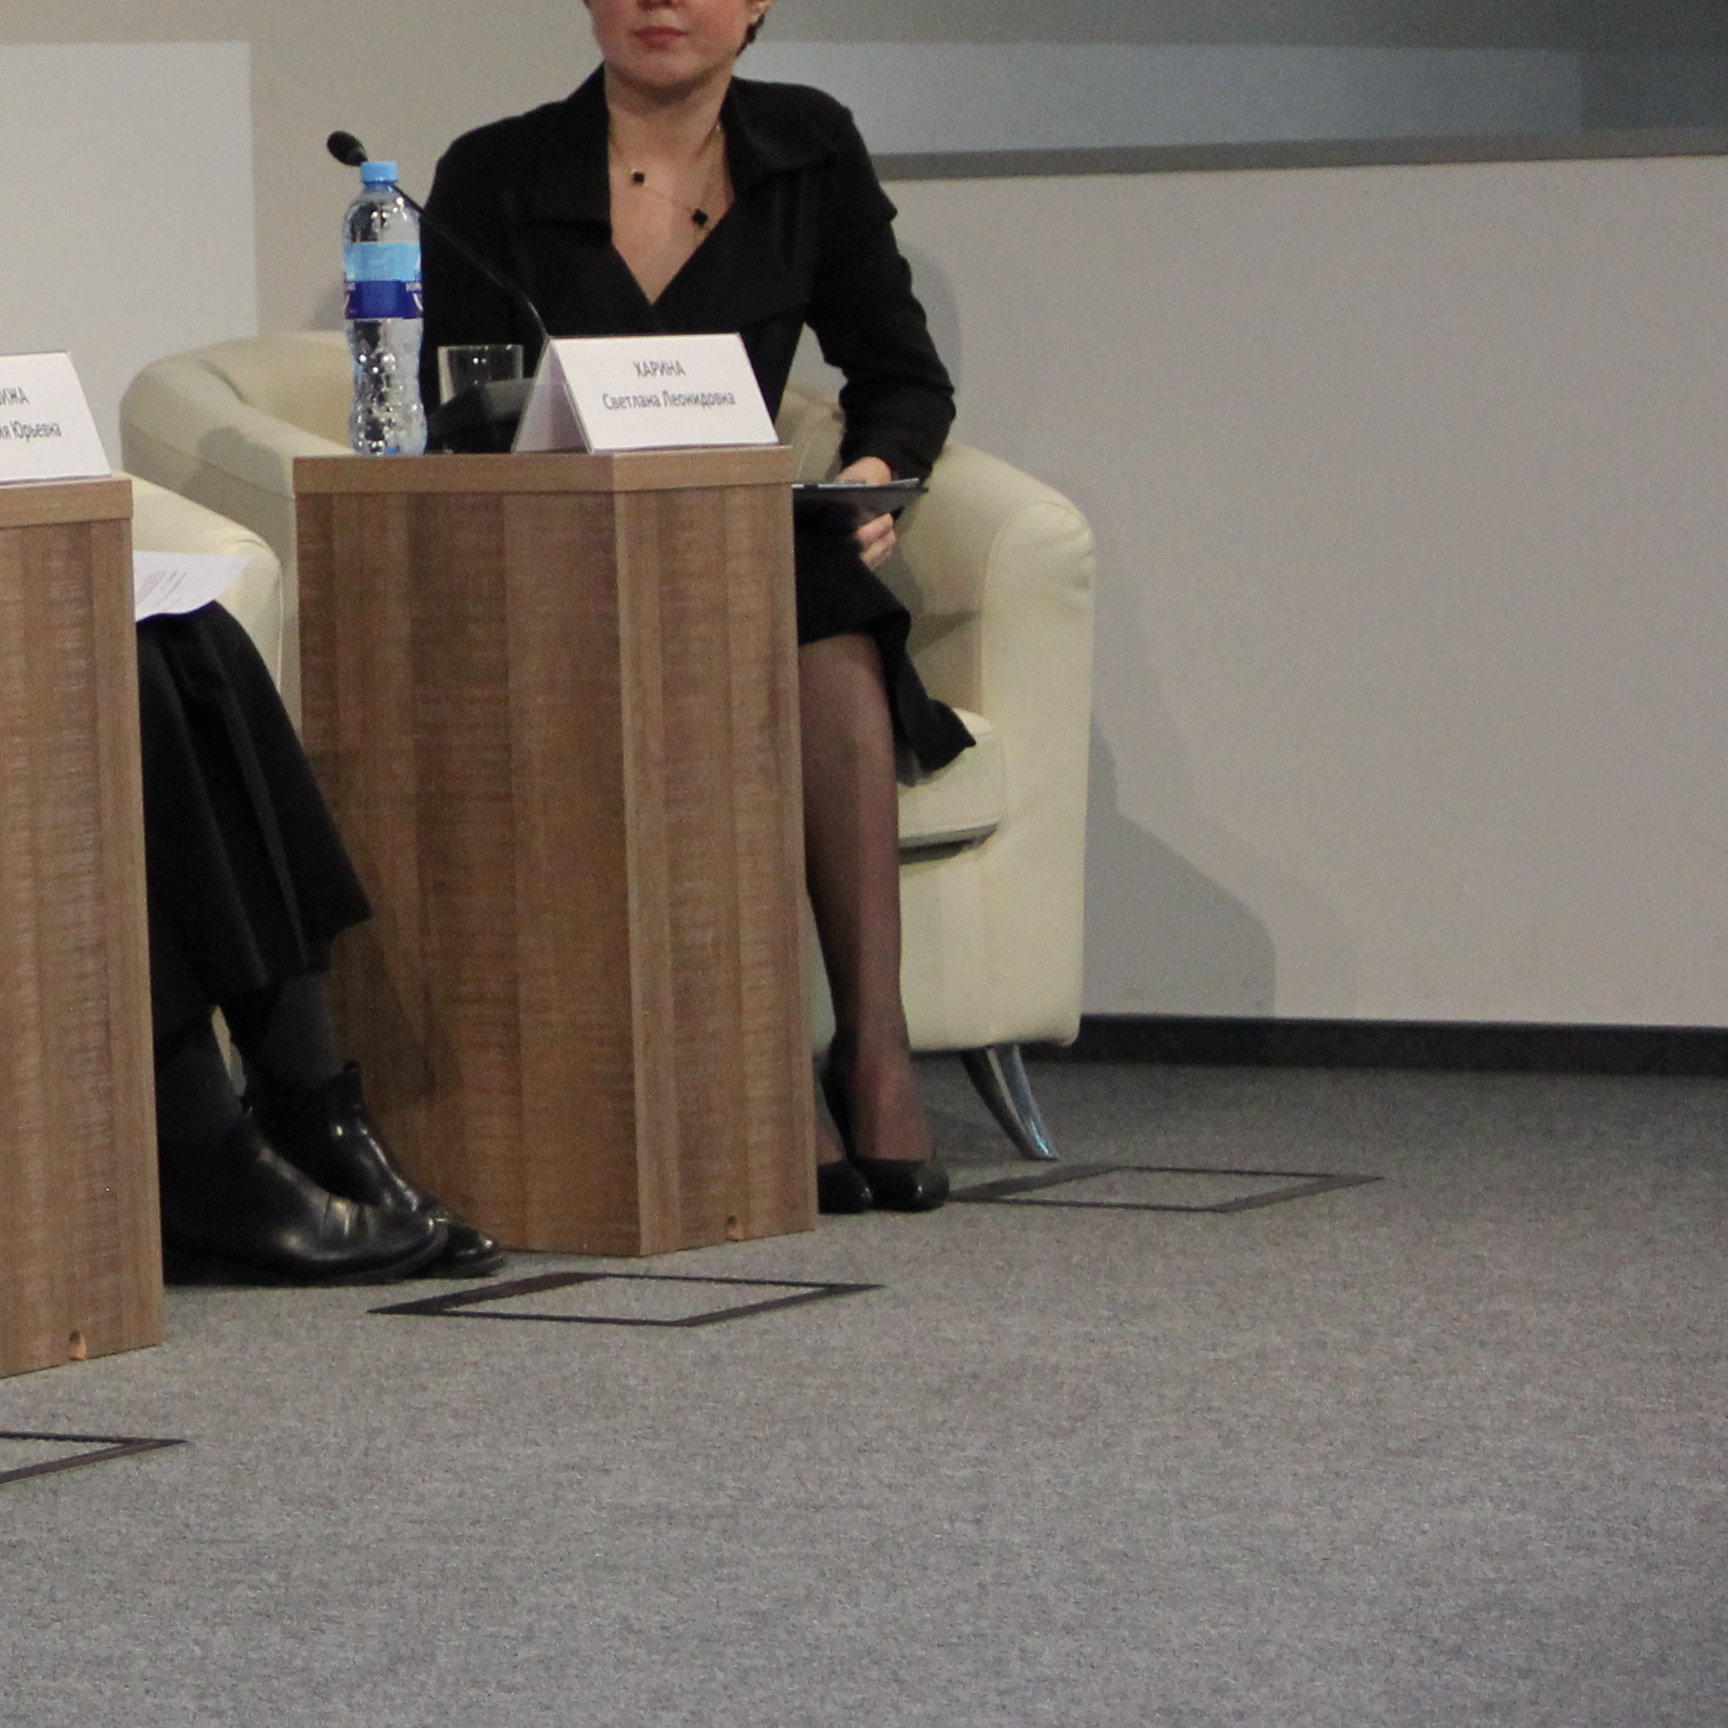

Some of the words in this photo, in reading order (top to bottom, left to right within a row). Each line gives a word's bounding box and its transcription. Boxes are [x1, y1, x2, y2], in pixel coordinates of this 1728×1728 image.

[633, 360, 687, 377] ХАРИНА
[602, 393, 662, 410] Светлана
[661, 389, 736, 410] Леонидовна
[10, 420, 62, 443] Юрьевна
